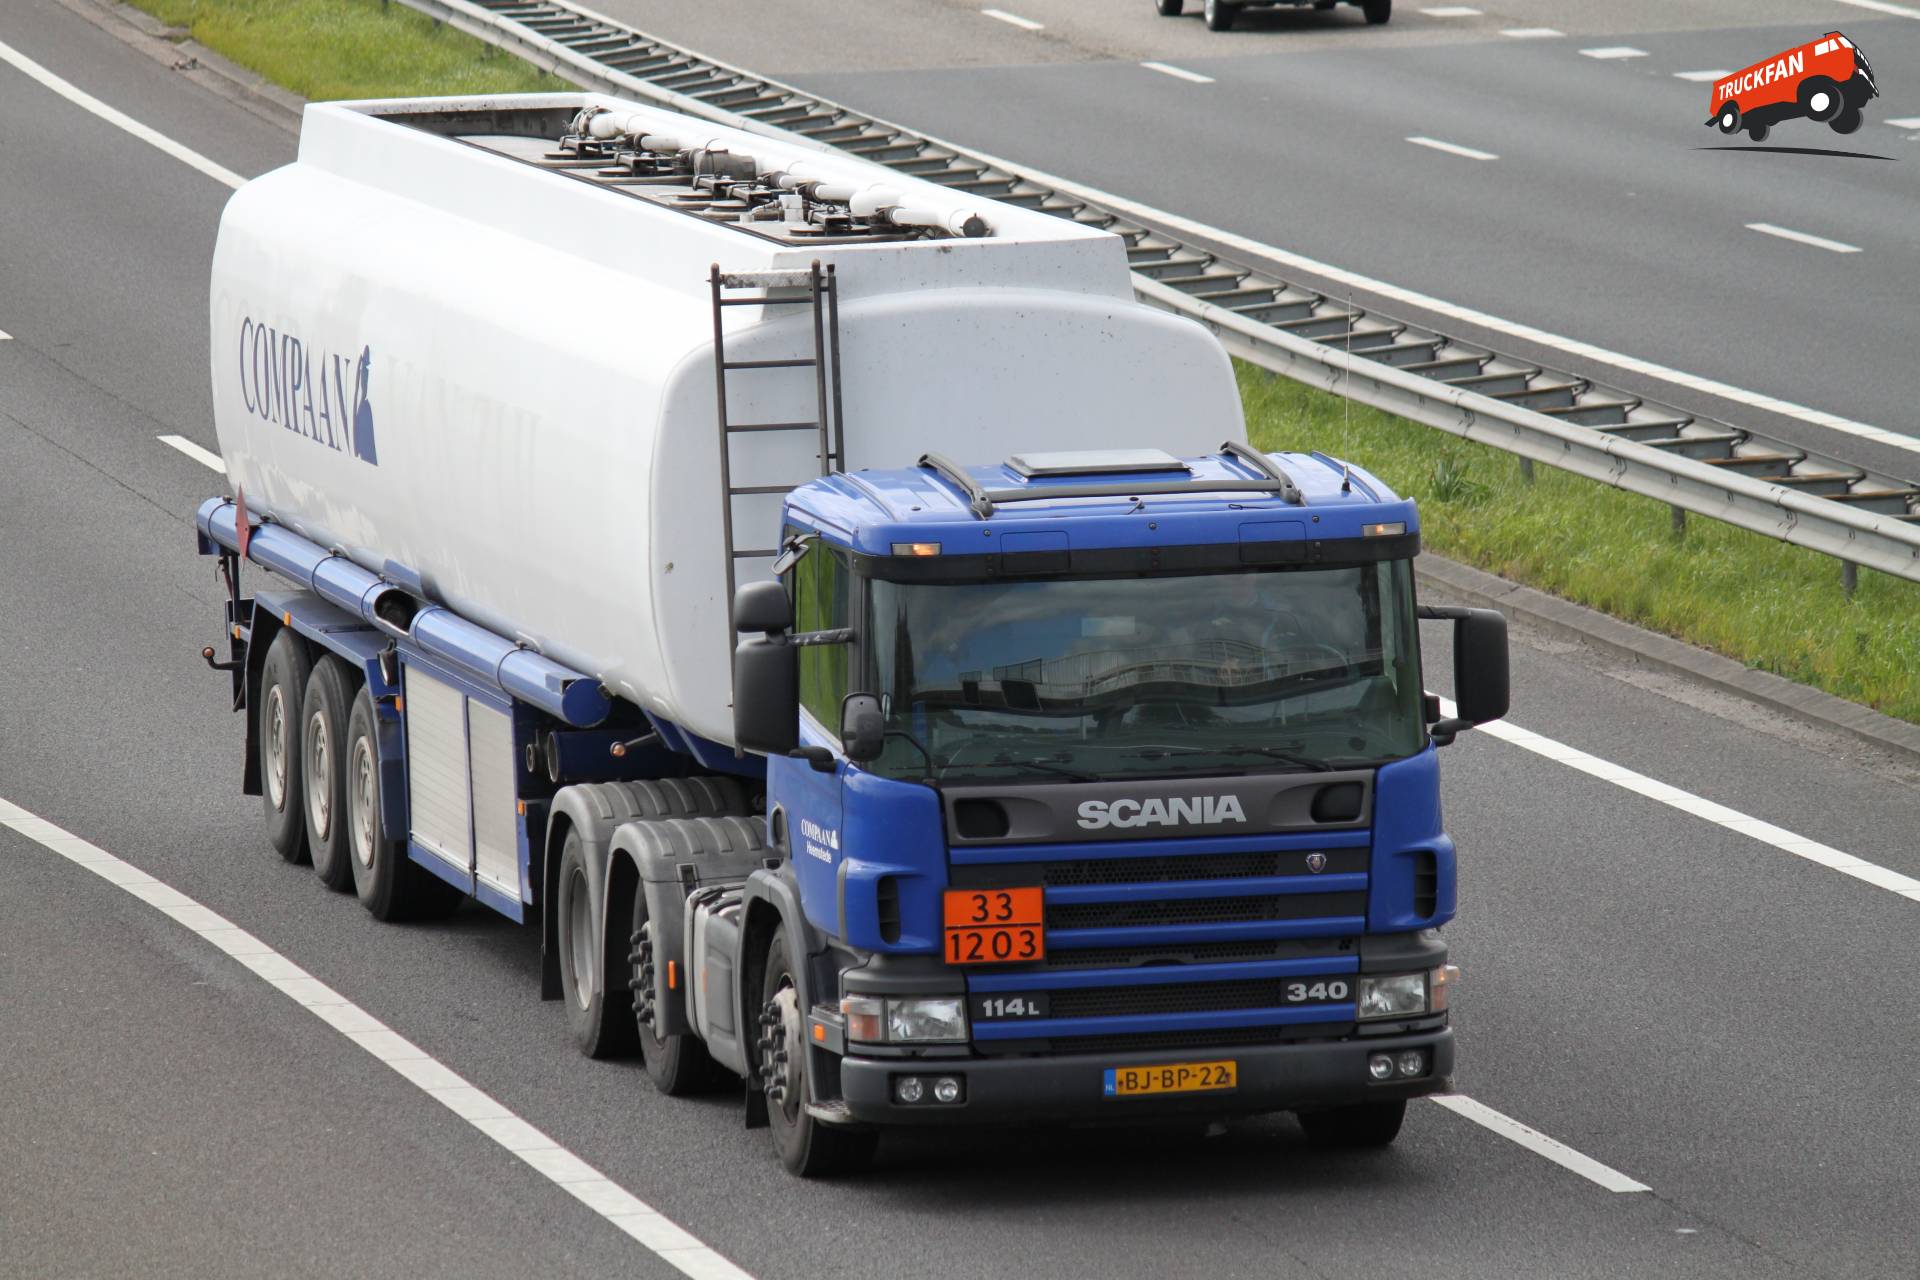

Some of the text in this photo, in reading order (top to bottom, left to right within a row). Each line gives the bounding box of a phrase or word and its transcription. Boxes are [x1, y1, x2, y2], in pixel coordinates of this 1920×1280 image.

[239, 316, 351, 456] COMPAAN
[1076, 795, 1247, 829] SCANIA
[801, 818, 832, 847] COMPAAN
[971, 892, 1013, 922] 33
[950, 929, 1037, 961] 1203
[1287, 981, 1348, 1001] 340
[1125, 1065, 1227, 1091] BJ-BP-22
